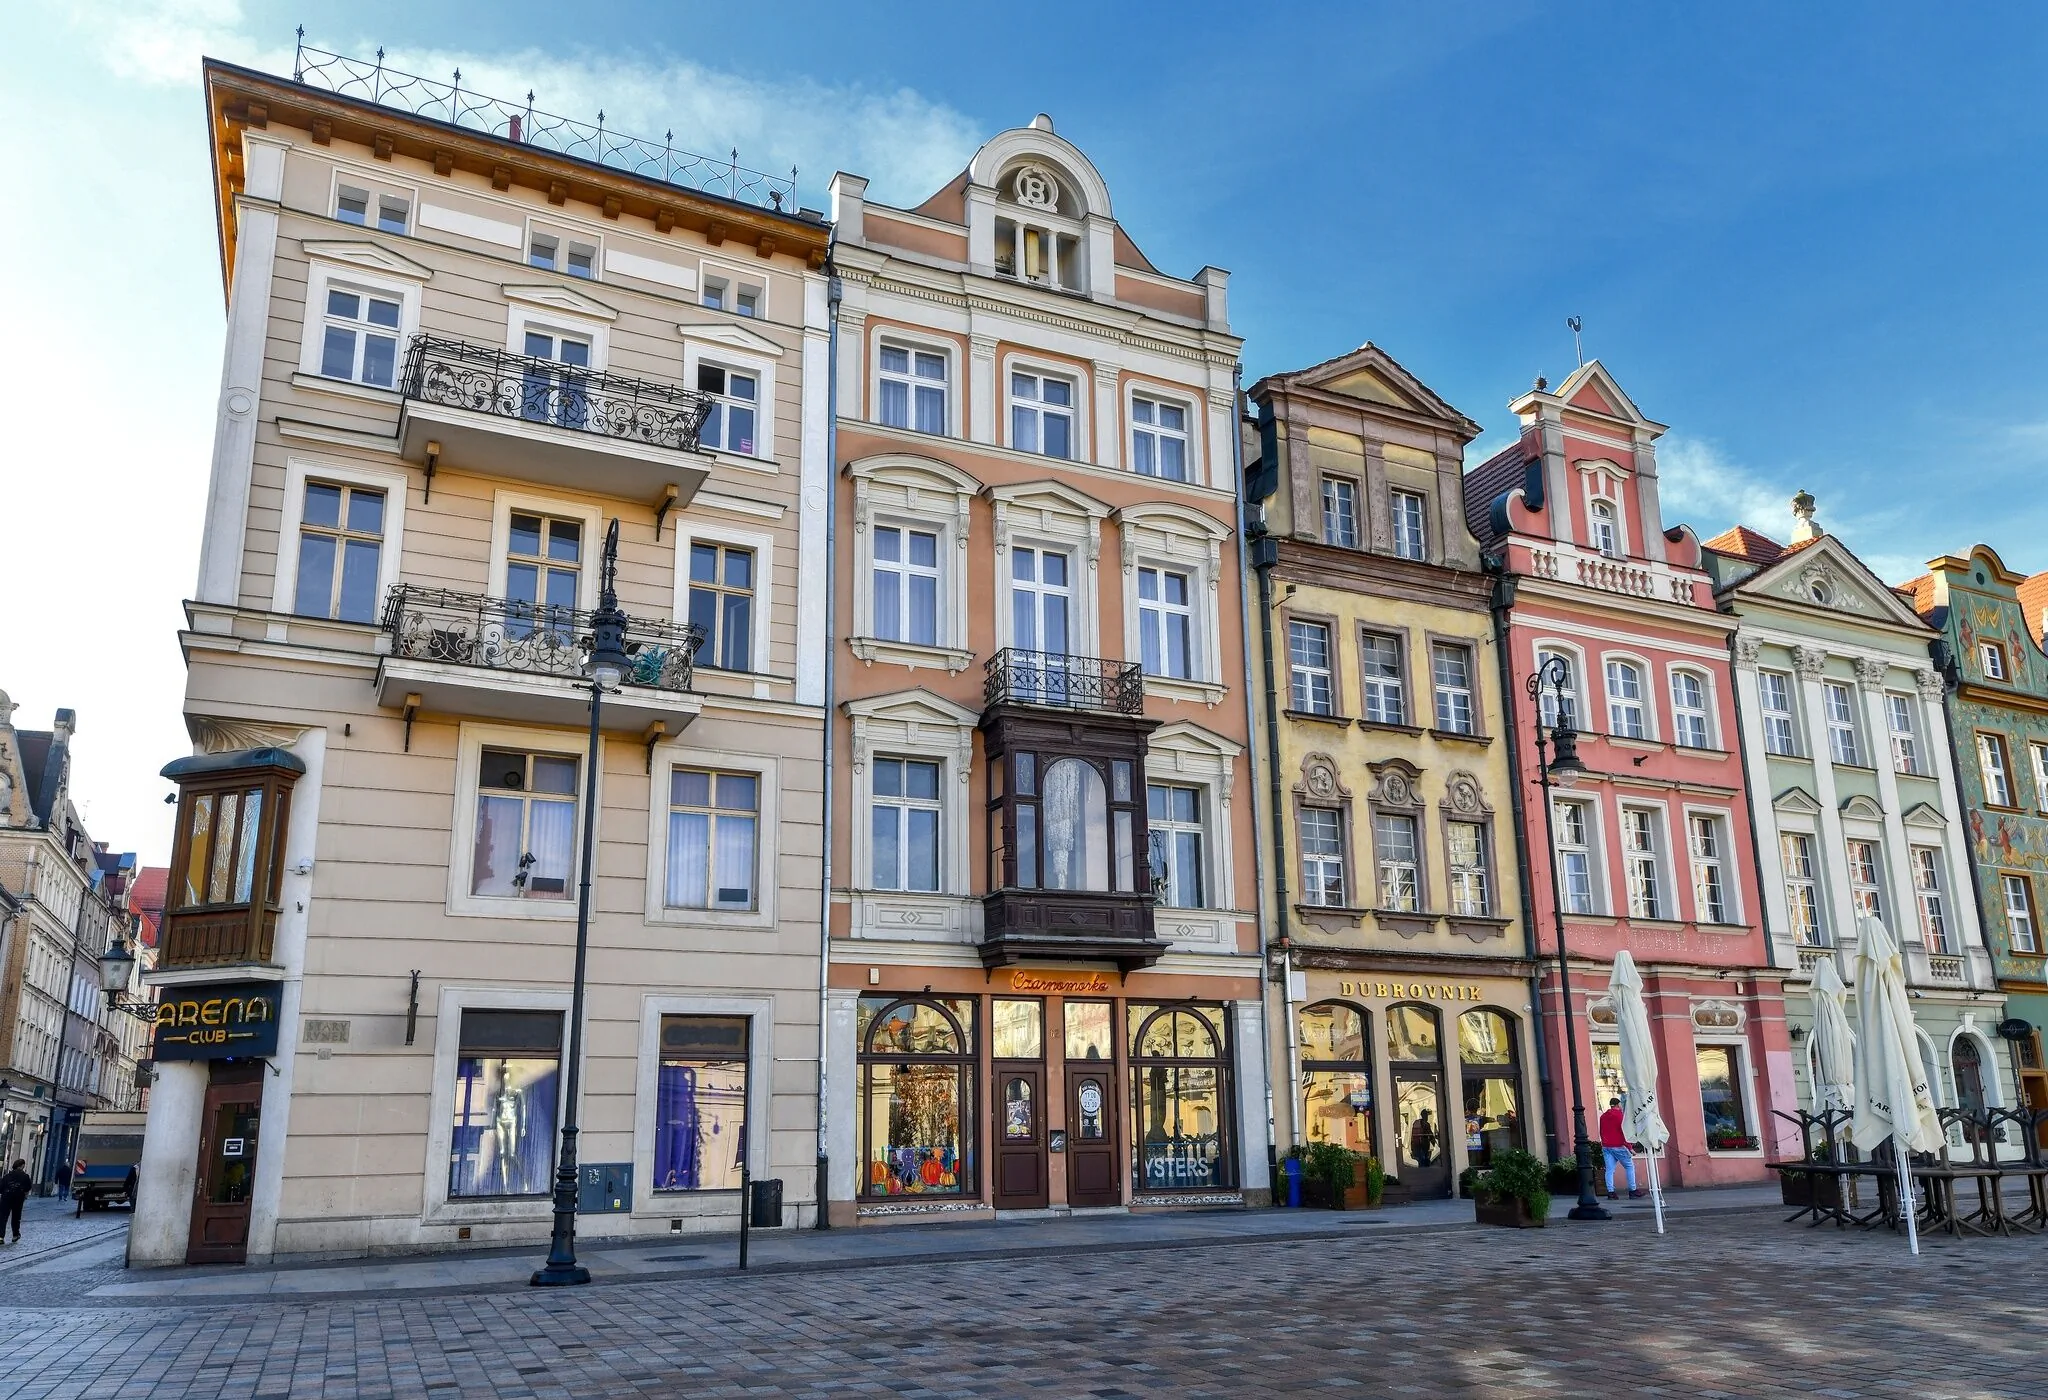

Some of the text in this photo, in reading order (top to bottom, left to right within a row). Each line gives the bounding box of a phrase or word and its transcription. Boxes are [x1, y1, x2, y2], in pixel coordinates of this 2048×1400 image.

[1023, 176, 1046, 205] B
[1013, 971, 1109, 992] Czarnomorka
[1340, 981, 1483, 1001] DUBROVNIK
[156, 997, 267, 1028] ARENA
[189, 1029, 226, 1044] CLUB
